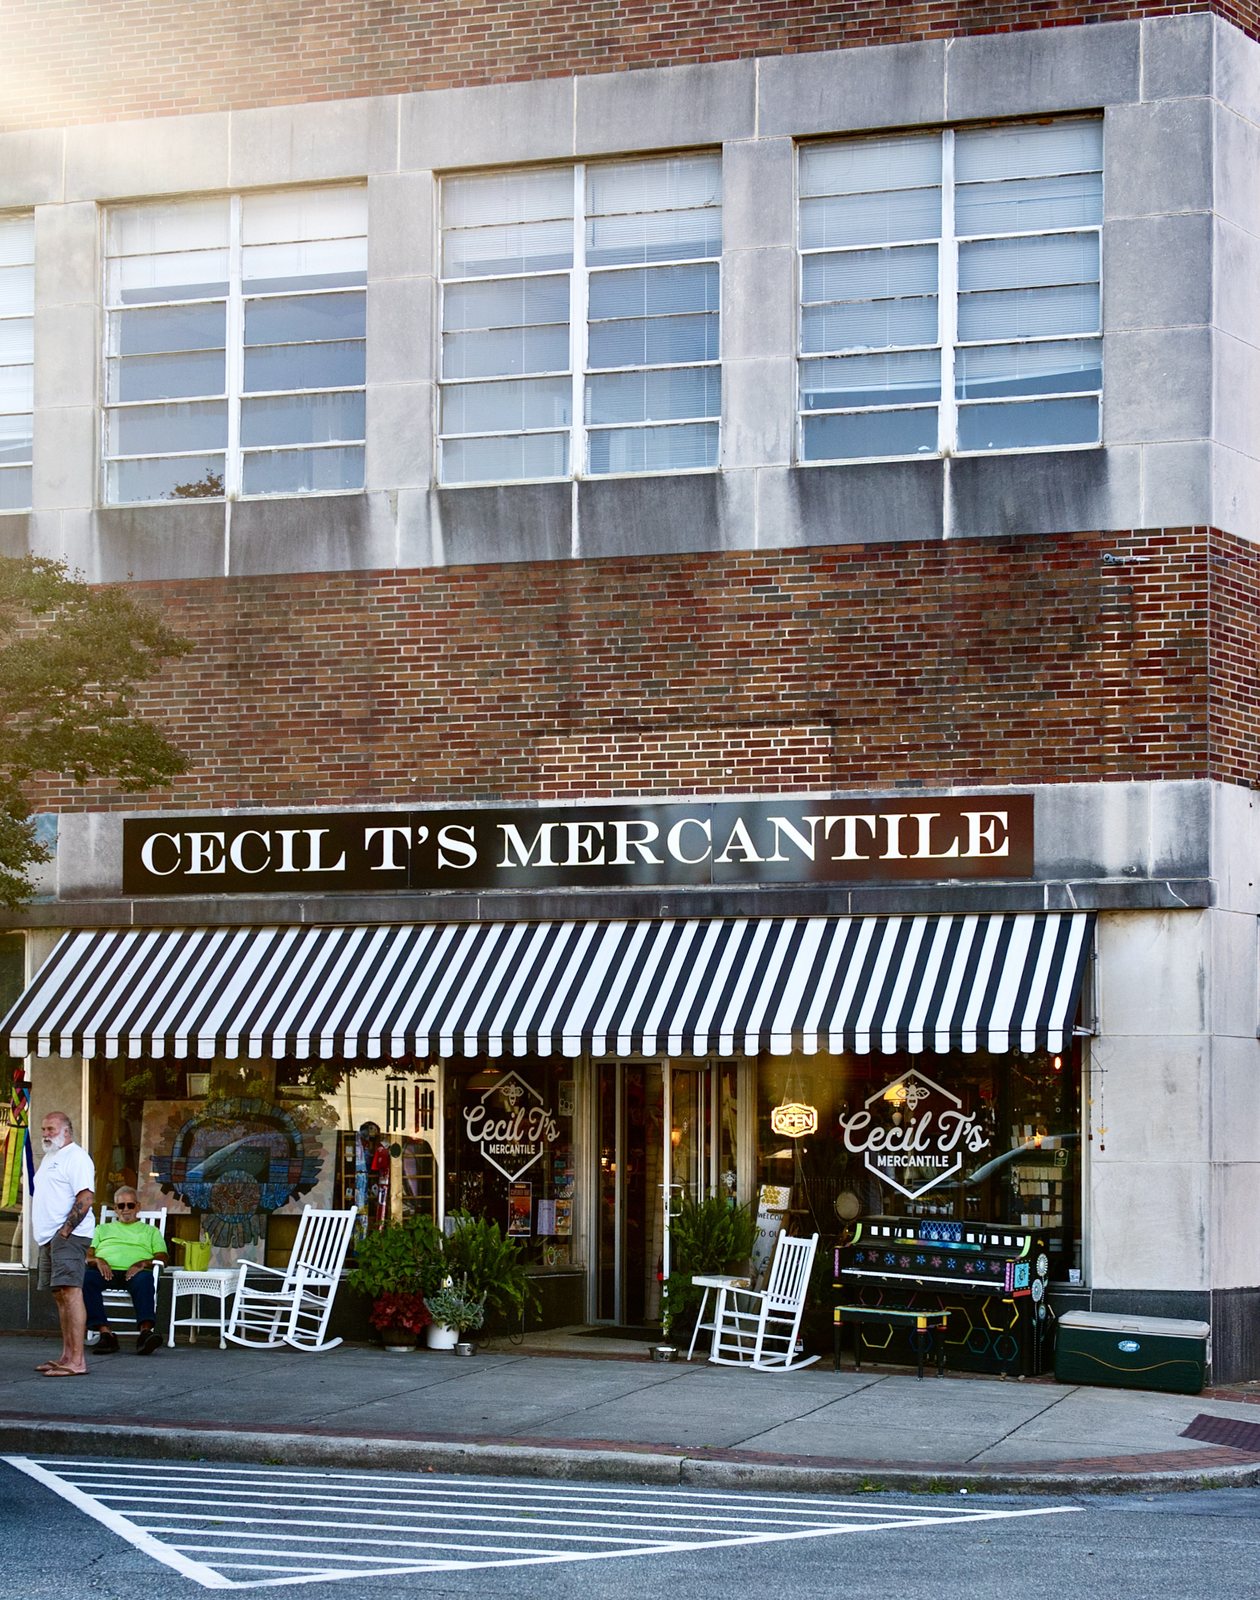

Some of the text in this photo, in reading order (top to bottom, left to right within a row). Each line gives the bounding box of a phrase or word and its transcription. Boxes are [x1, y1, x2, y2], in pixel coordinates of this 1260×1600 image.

[140, 811, 1010, 876] CECIL T'S MERCANTILE
[463, 1105, 525, 1142] Cecil
[775, 1113, 813, 1128] OPEN
[839, 1110, 933, 1153] Cecil
[489, 1144, 536, 1155] MERCANTILE
[877, 1155, 949, 1168] MERCANTILE
